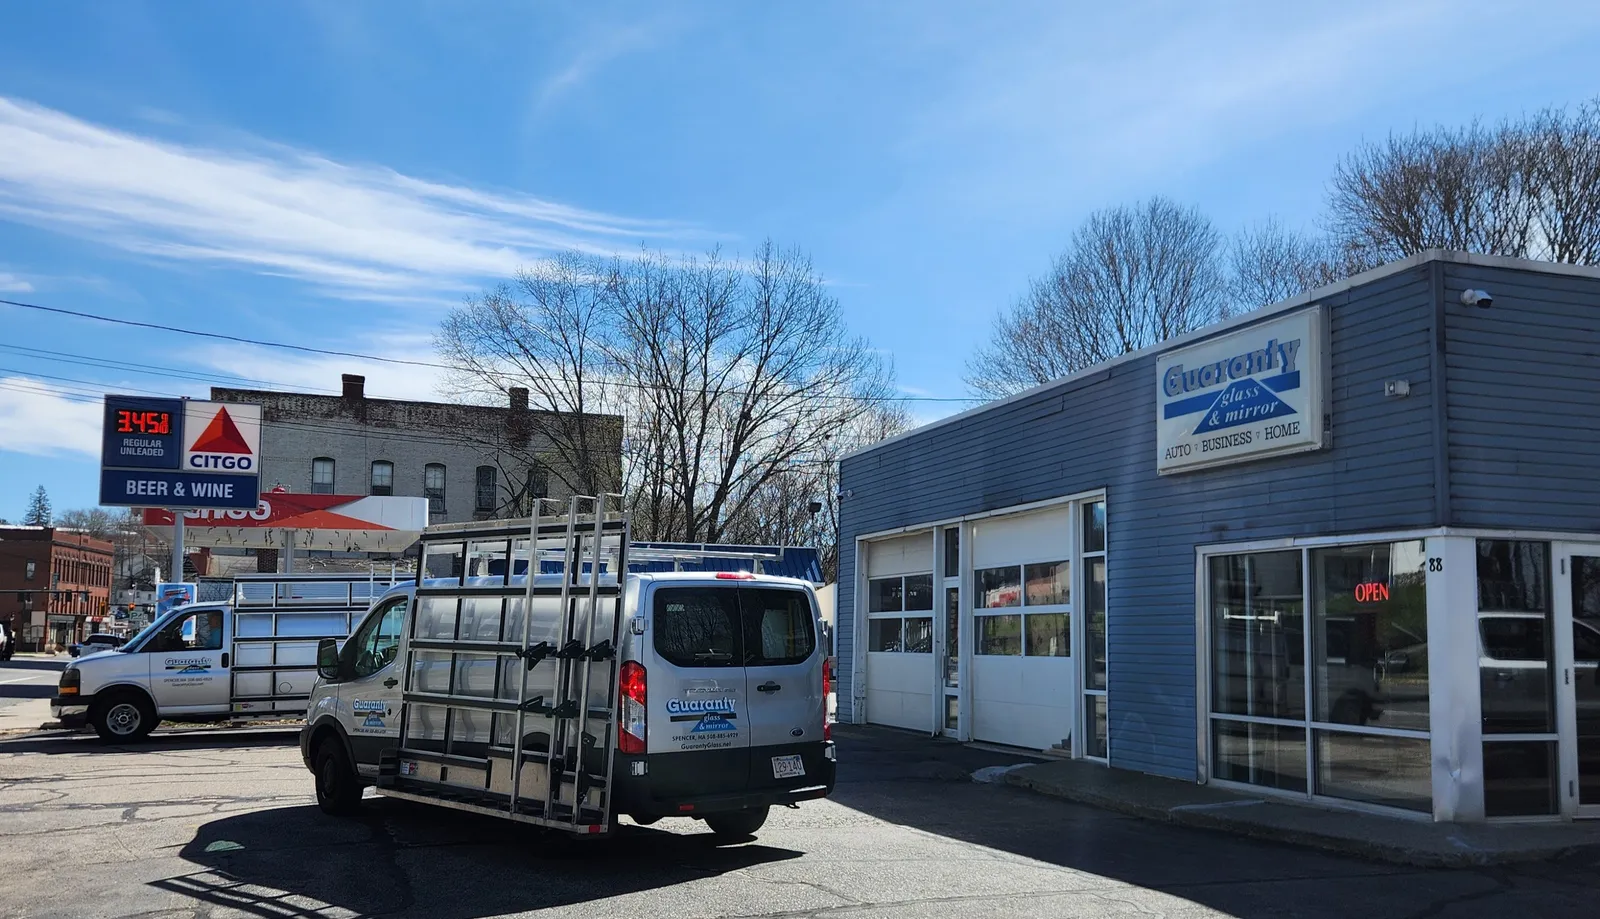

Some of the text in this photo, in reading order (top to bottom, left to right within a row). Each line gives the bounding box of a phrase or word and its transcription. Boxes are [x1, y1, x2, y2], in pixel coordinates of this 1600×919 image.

[1163, 338, 1300, 398] Guaranty
[1220, 385, 1260, 408] glass
[1208, 400, 1279, 426] & mirror
[123, 438, 162, 448] REGULAR
[1165, 421, 1300, 460] AUTO BUSINESS HOME
[120, 447, 164, 456] UNLEADED
[190, 454, 252, 470] CITGO
[126, 480, 233, 498] BEER & WINE
[1428, 557, 1443, 572] 88
[1355, 583, 1389, 602] OPEN
[164, 657, 212, 666] Guaranty
[353, 698, 387, 711] Guaranty
[666, 696, 736, 714] Guaranty
[703, 713, 721, 723] glass
[699, 722, 729, 730] & mirror
[680, 741, 732, 750] GuarantyGlass.net
